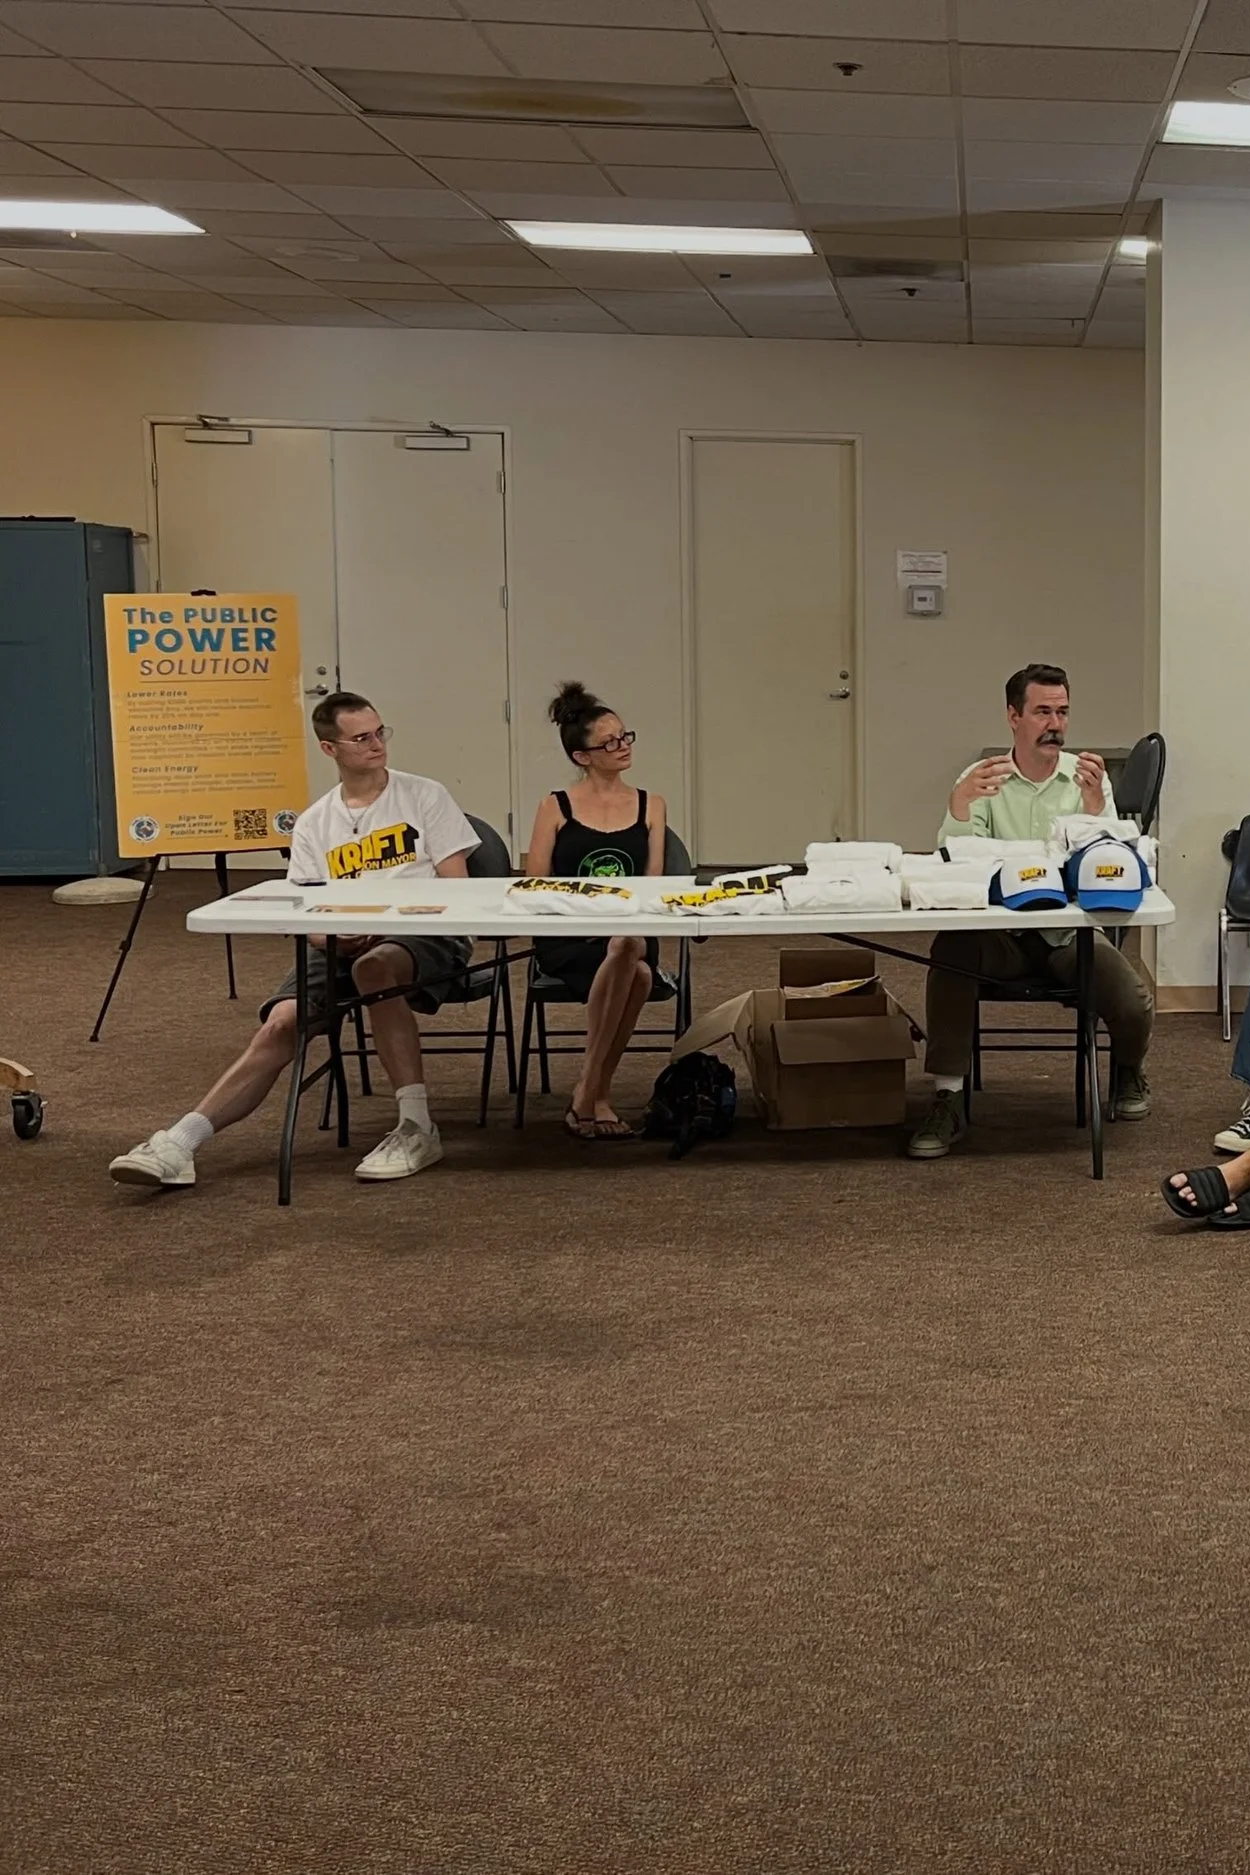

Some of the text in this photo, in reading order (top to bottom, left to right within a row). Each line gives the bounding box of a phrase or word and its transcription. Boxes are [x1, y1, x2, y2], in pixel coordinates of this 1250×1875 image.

[123, 607, 278, 624] The PUBLIC
[127, 627, 277, 653] POWER
[140, 657, 269, 677] SOLUTION
[129, 723, 204, 732] Accountability
[132, 765, 199, 774] Clean Energy
[326, 822, 419, 880] KRAFT
[381, 852, 417, 869] MAYOR
